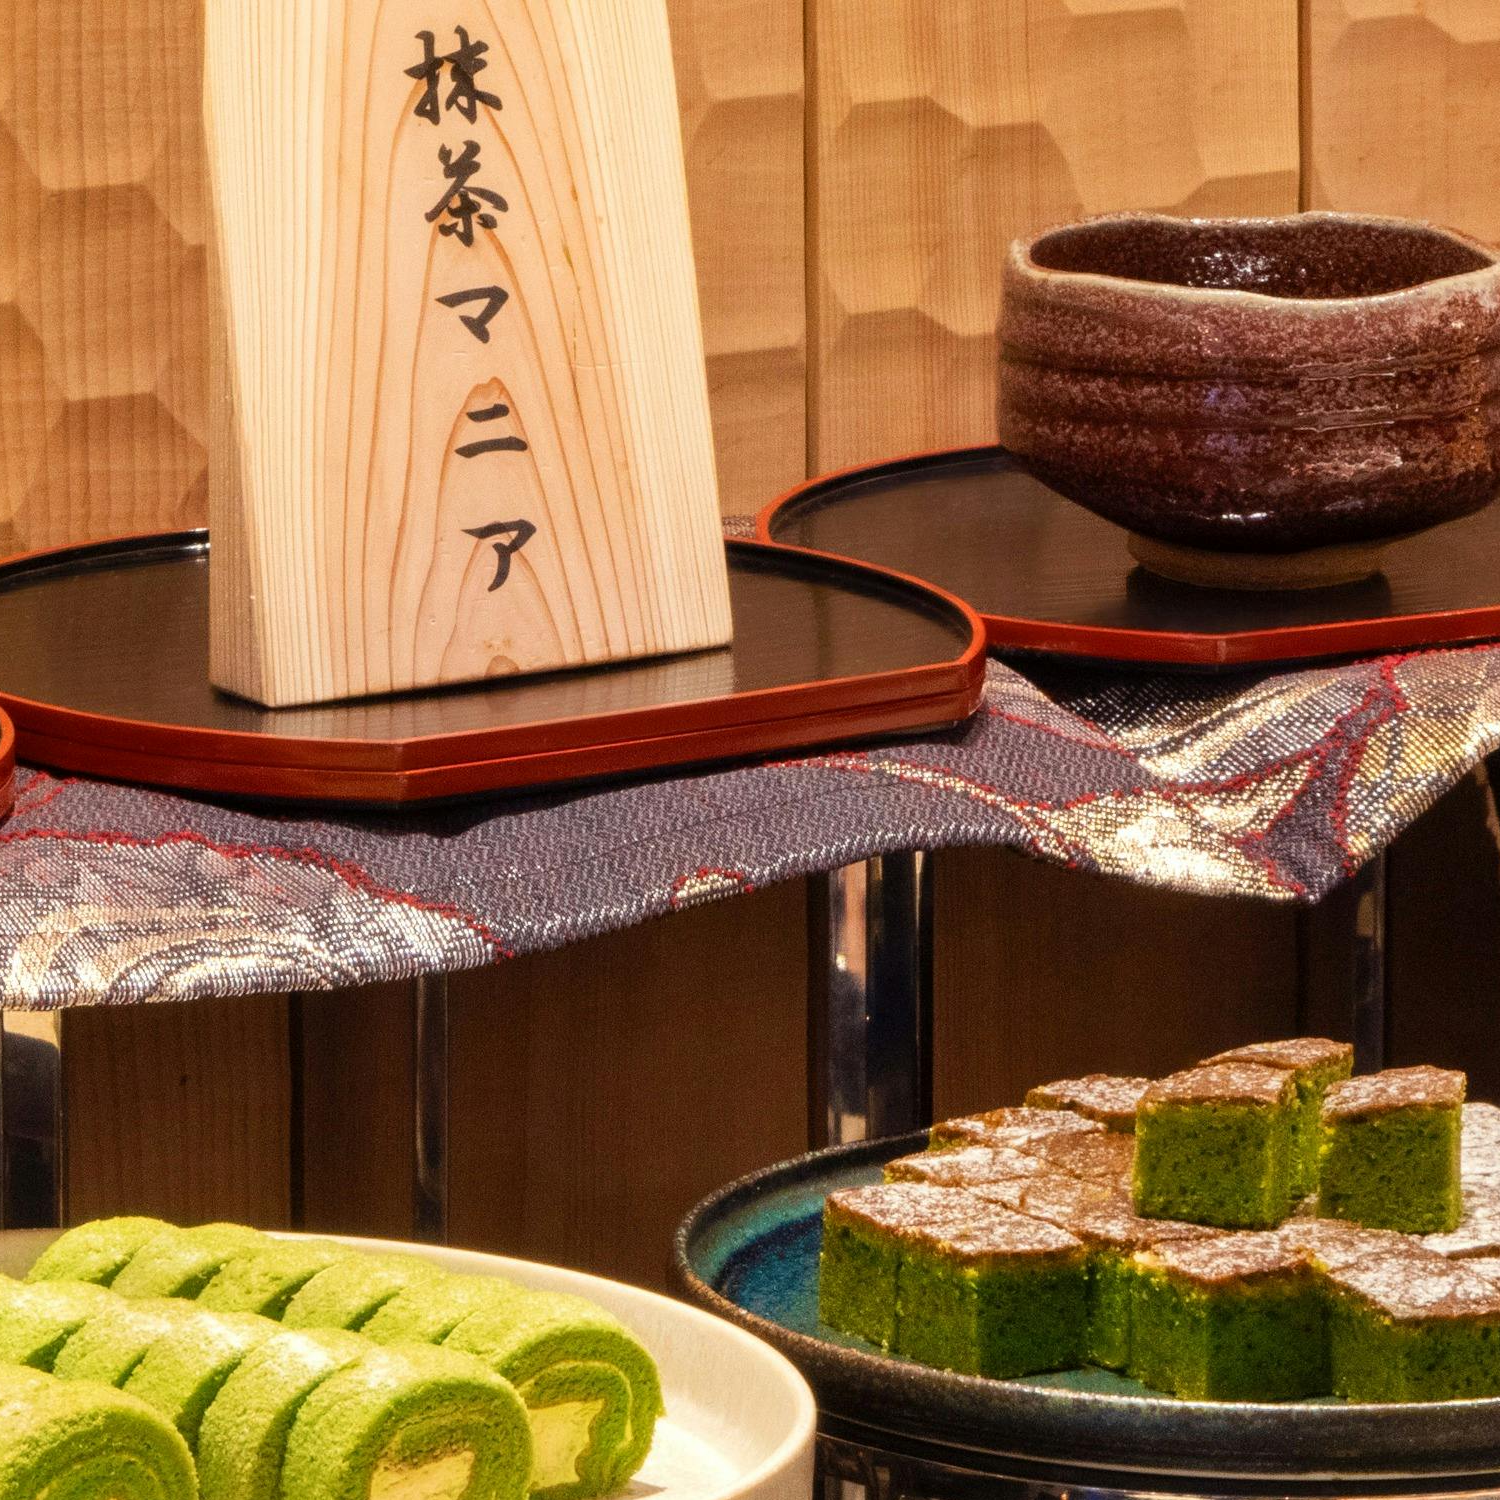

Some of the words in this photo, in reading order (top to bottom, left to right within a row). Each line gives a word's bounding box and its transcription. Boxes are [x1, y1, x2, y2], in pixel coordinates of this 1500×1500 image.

[405, 25, 537, 592] 抹茶マニア
